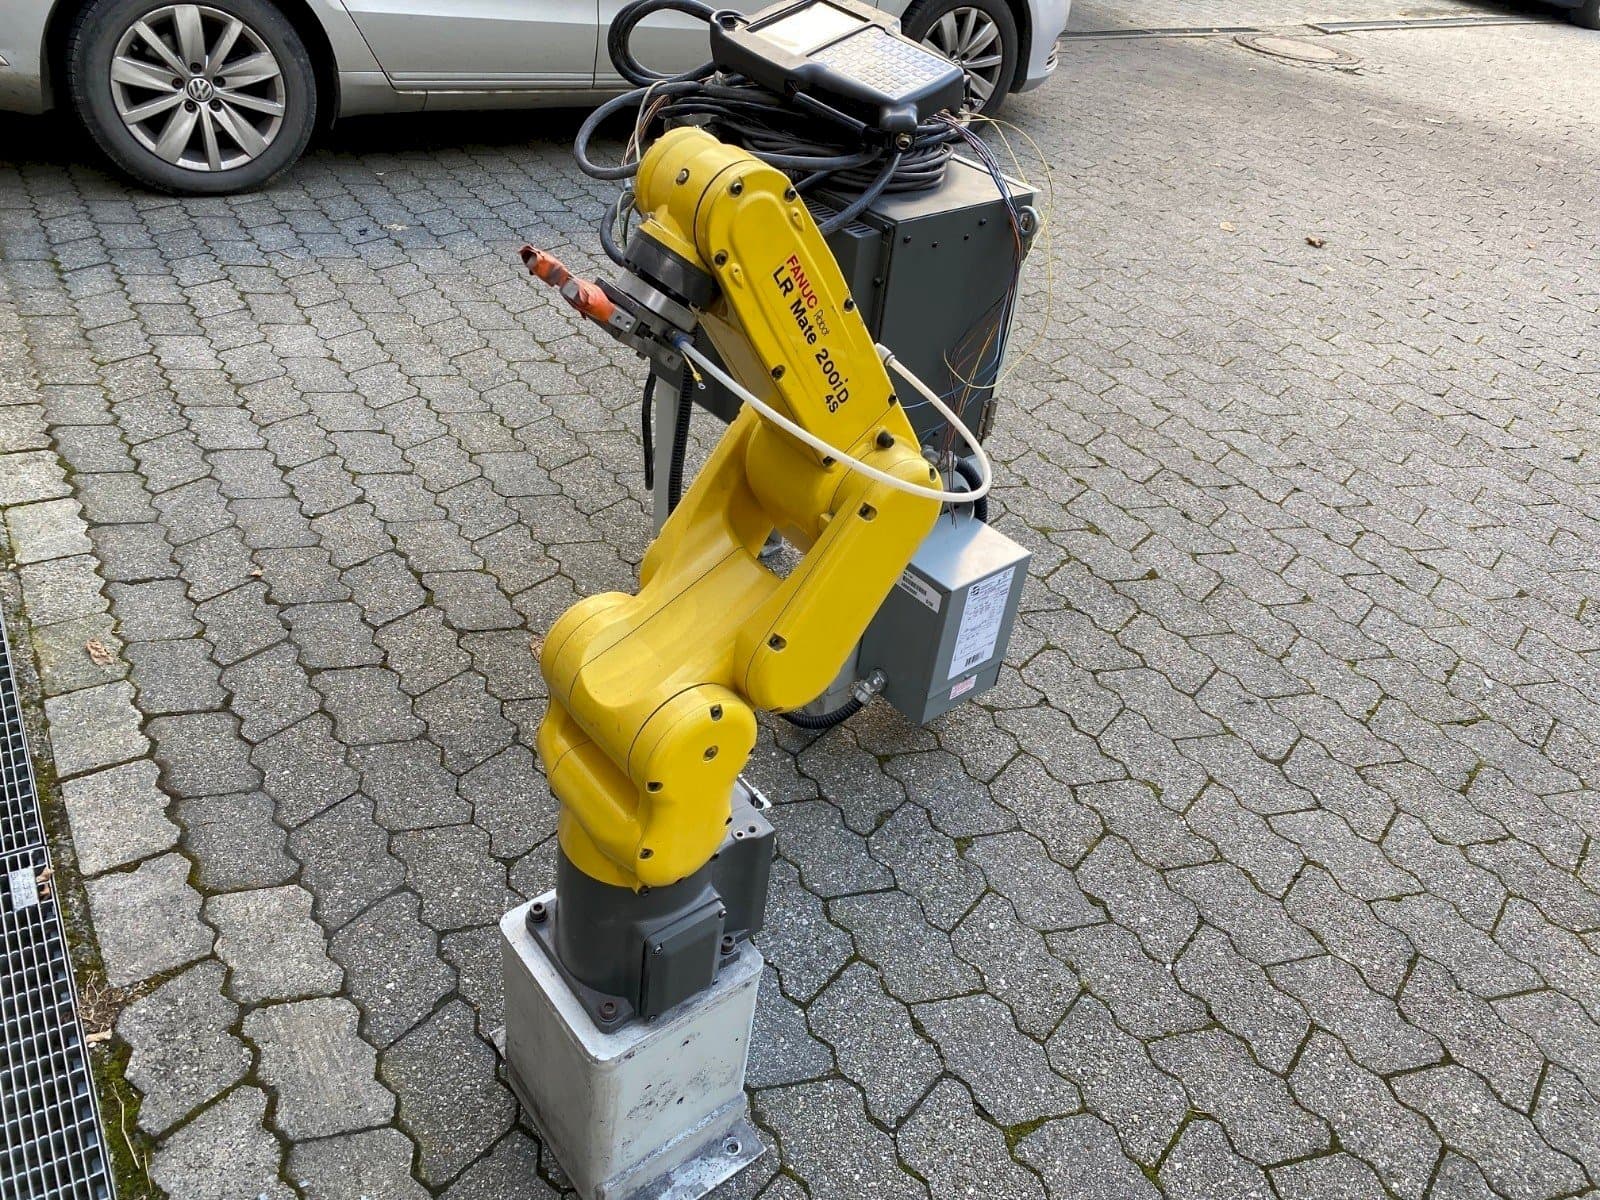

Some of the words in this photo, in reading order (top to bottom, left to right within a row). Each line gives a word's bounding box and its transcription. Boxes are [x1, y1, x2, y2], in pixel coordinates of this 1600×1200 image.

[188, 77, 213, 101] VW
[786, 254, 818, 309] FANUC
[813, 309, 830, 336] Robot
[773, 266, 794, 298] LR
[790, 298, 817, 345] Mate
[815, 348, 849, 404] 200iD
[825, 394, 839, 413] 4S
